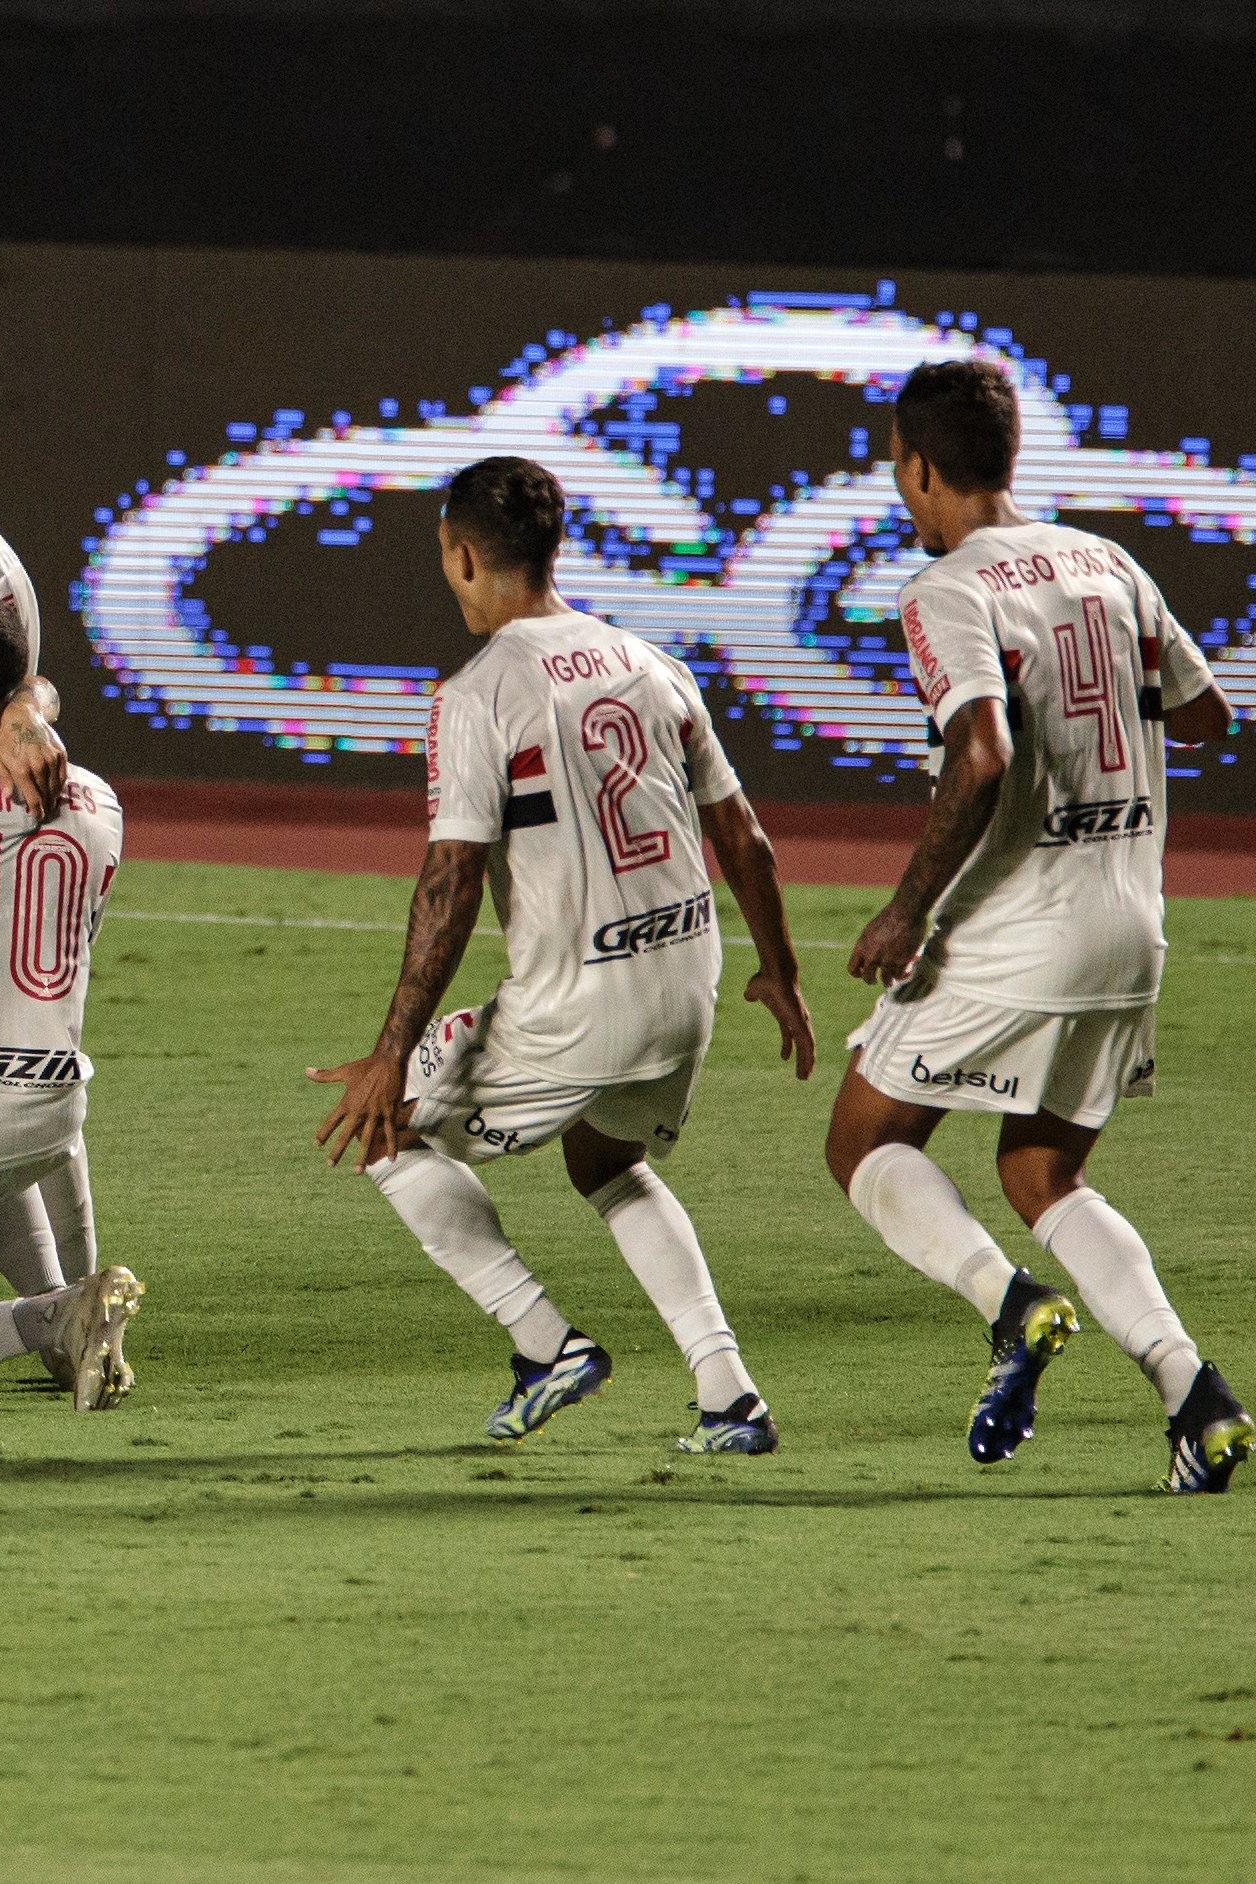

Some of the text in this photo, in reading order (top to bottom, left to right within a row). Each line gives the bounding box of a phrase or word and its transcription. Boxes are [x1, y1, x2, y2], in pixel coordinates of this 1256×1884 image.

[976, 553, 1056, 593] DIEGO
[541, 647, 612, 686] IGOR
[1053, 596, 1126, 773] 4
[581, 697, 670, 876] 2
[591, 889, 711, 955] GAZIN
[910, 1054, 1020, 1099] betsul
